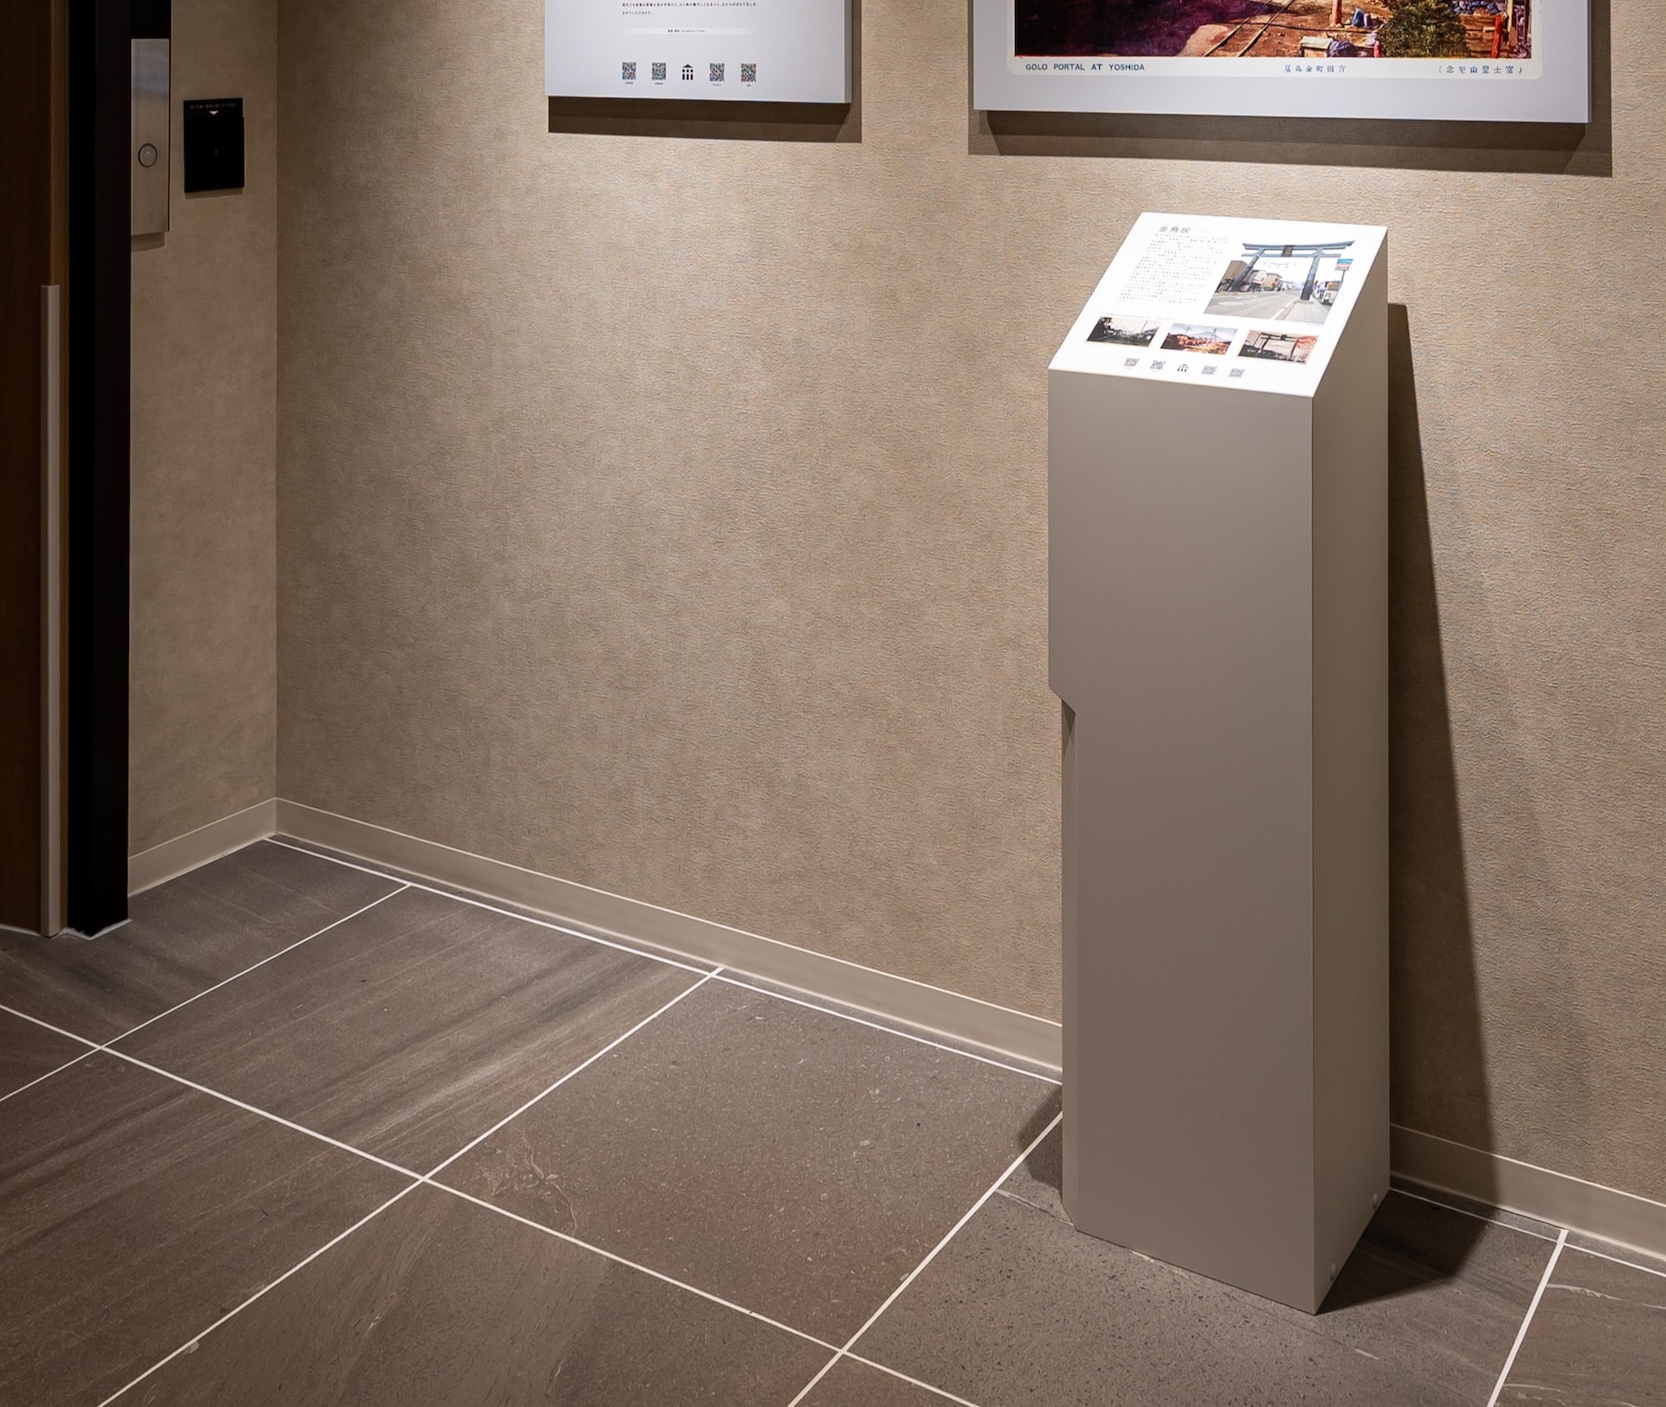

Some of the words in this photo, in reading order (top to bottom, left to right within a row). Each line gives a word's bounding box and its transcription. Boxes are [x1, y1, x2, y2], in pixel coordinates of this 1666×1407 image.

[1053, 63, 1086, 71] PORTAL
[1091, 63, 1103, 71] AT
[1108, 63, 1145, 71] YOSHIDA
